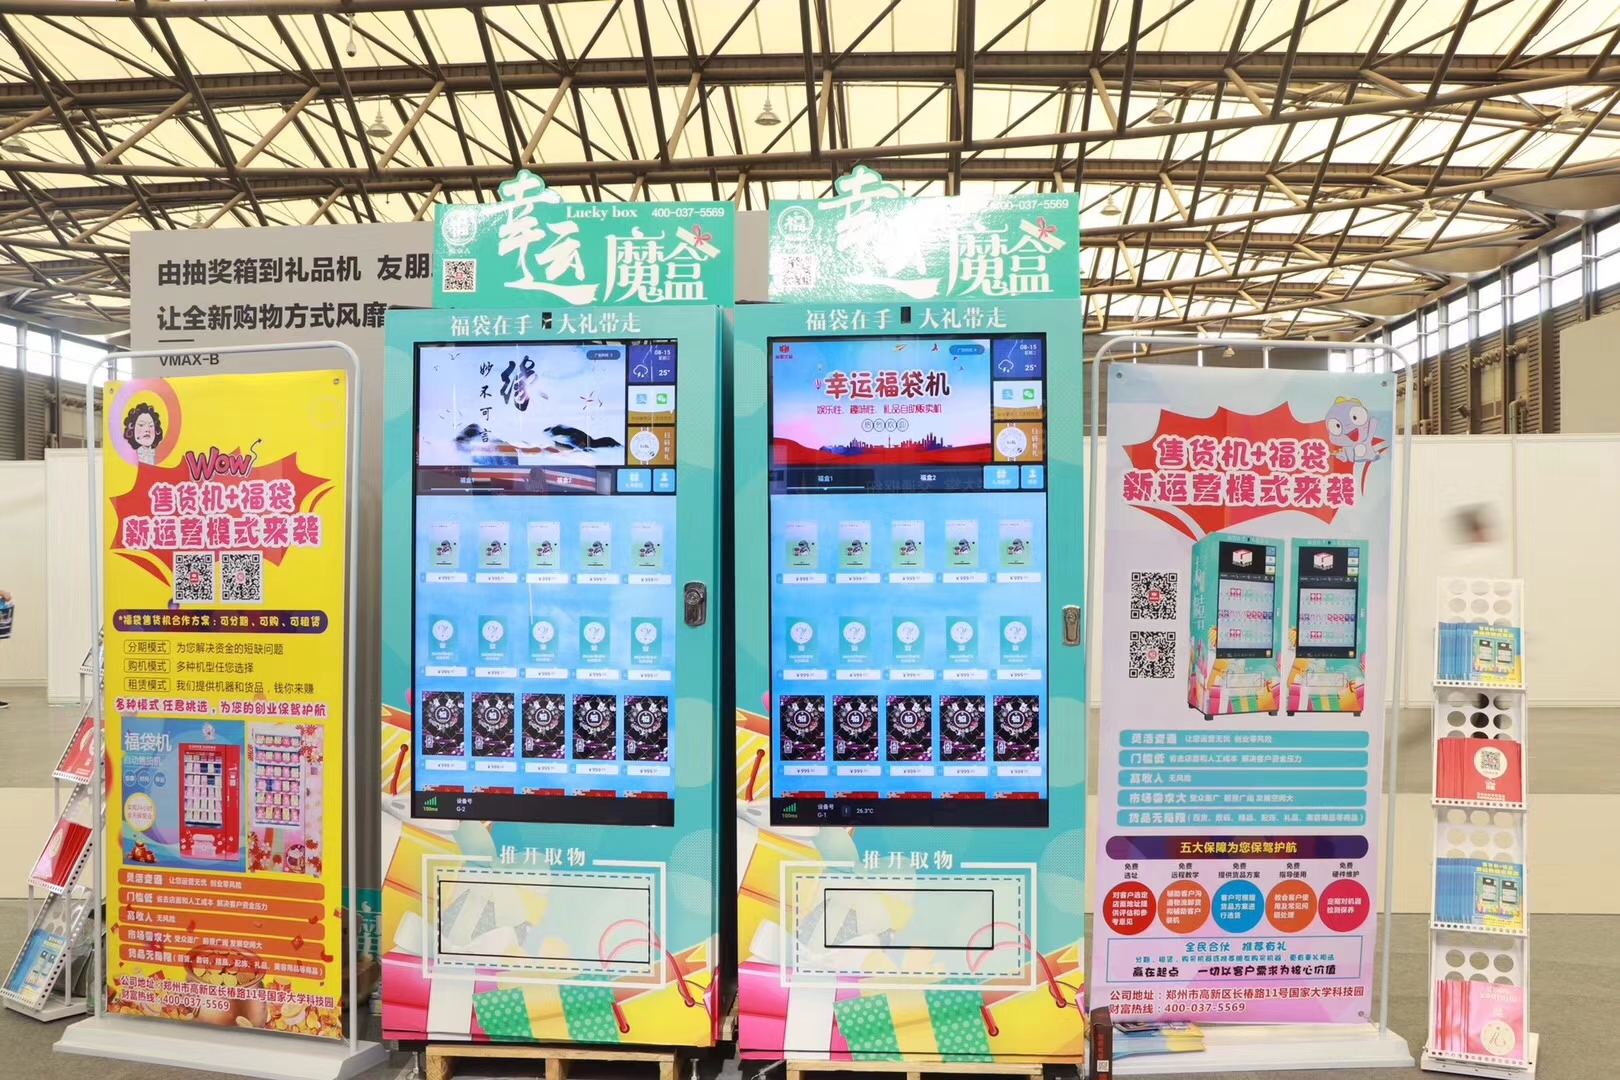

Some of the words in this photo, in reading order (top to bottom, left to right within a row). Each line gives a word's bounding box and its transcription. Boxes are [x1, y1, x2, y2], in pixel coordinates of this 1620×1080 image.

[988, 198, 1069, 210] 00-037-5569
[566, 205, 609, 220] Lucky
[612, 205, 638, 218] box
[651, 206, 725, 218] 400-037-5569
[157, 256, 362, 286] 由抽奖箱到礼品机
[377, 252, 433, 280] 友朋
[157, 301, 386, 331] 让全新购物方式风靡
[806, 308, 893, 331] 福袋在手
[919, 306, 1008, 330] 大礼带走
[451, 313, 533, 337] 福袋在手
[557, 311, 642, 335] 大礼带走
[159, 353, 220, 367] VMAX-B
[824, 371, 950, 400] 幸运福袋机
[479, 361, 495, 444] 妙不可言
[1155, 436, 1327, 471] 售货机+福袋
[186, 447, 252, 480] Wow
[1122, 471, 1355, 507] 新运营模式来袭
[150, 482, 295, 513] 售货机+福袋
[124, 515, 320, 548] 新运营模式来袭
[128, 641, 167, 653] 分期模式
[176, 643, 284, 655] 为您解决资金的短缺问题
[128, 660, 167, 672] 购机模式
[176, 661, 254, 673] 多种机型任您选择
[128, 679, 167, 691] 租赁模式
[125, 732, 171, 752] 福袋机
[1180, 841, 1298, 854] 五大保障为您保驾护航
[499, 845, 587, 867] 推开取物
[862, 849, 954, 870] 推开取物
[1124, 862, 1139, 871] 免费
[1178, 862, 1193, 870] 免费
[1232, 862, 1247, 870] 免费
[1286, 862, 1300, 870] 免费
[1124, 871, 1138, 880] 选址
[1171, 871, 1200, 879] 远程教学
[1218, 871, 1261, 879] 提供货品方案
[1279, 870, 1307, 879] 指导使用
[1332, 870, 1360, 878] 硬件维护
[1185, 941, 1231, 952] 全民合伙
[1242, 941, 1287, 952] 推荐有礼
[1132, 966, 1180, 978] 赢在起点
[1197, 964, 1336, 977] 一切以客户需求为核心价值
